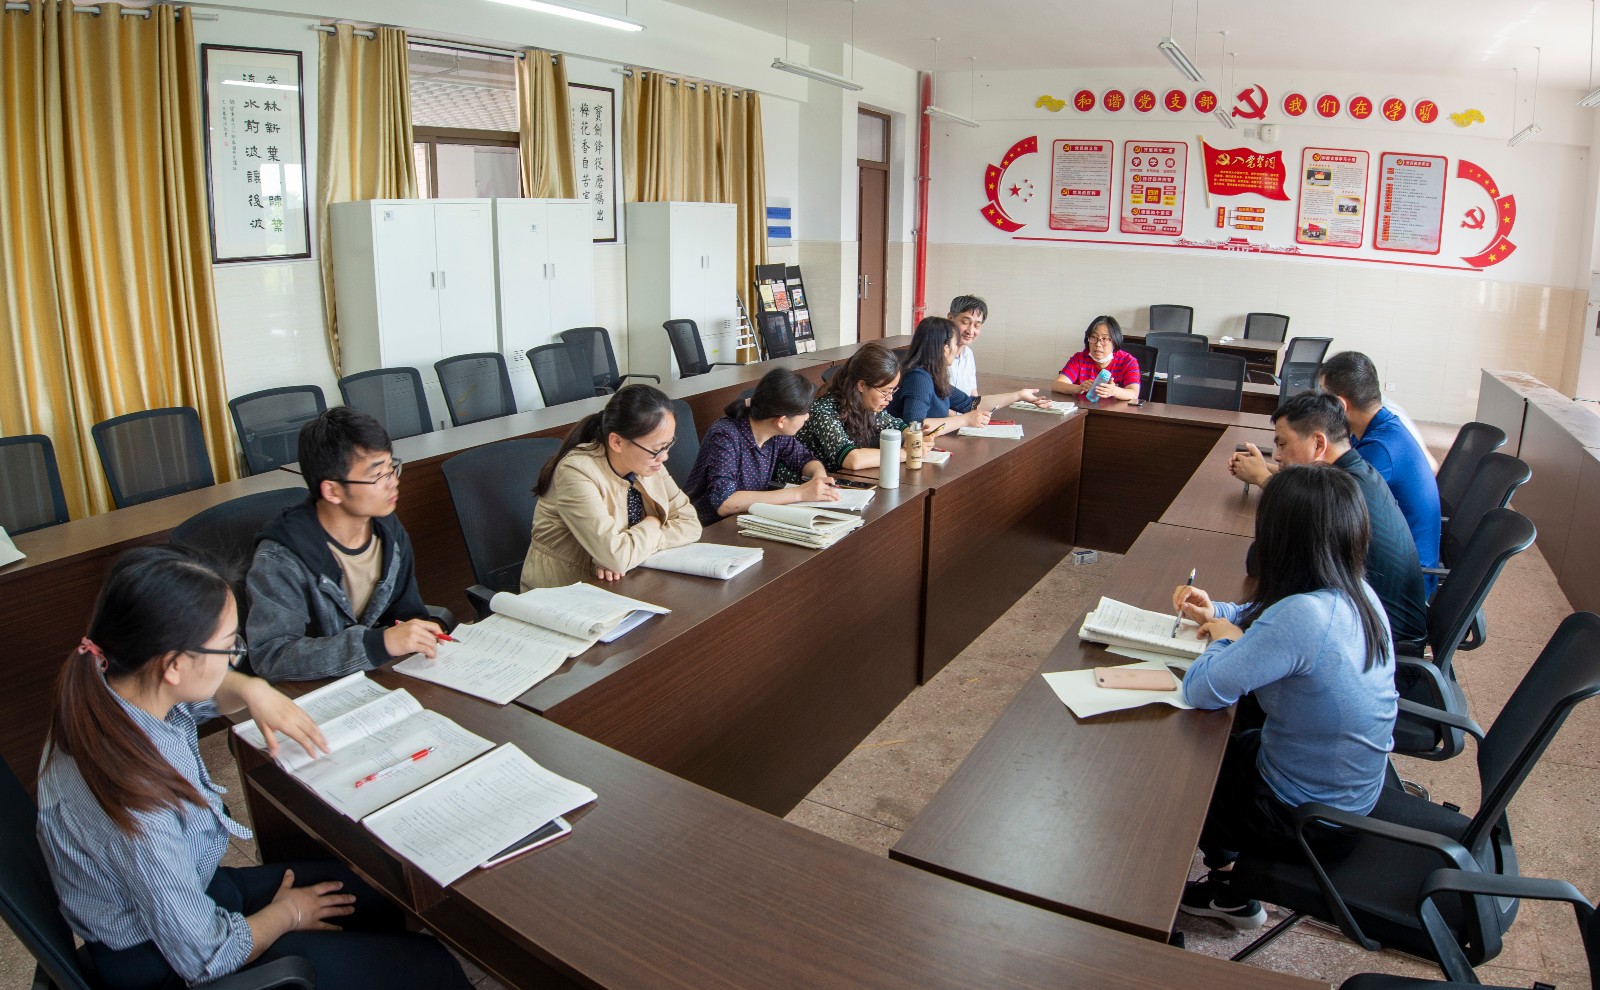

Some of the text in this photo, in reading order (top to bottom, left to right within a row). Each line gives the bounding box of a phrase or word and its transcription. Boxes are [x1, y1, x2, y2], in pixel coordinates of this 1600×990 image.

[1077, 93, 1215, 111] 和谐党支部
